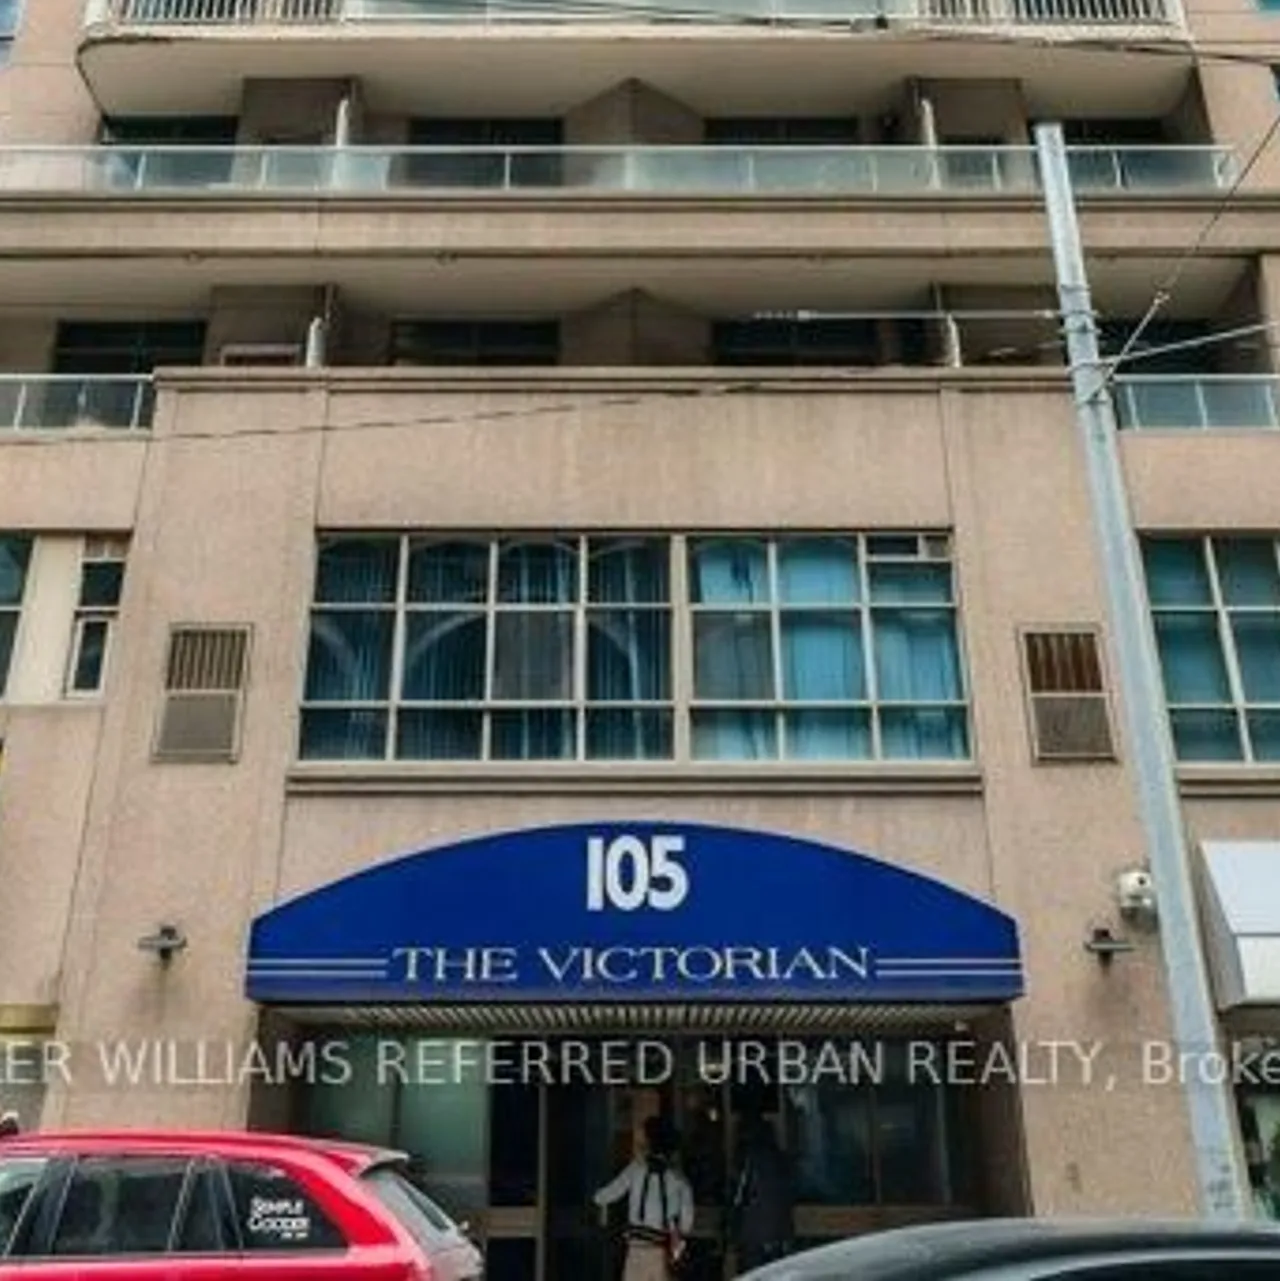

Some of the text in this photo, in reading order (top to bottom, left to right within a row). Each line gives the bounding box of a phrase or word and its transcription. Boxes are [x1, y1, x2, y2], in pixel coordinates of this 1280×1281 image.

[585, 834, 689, 912] 105
[392, 946, 868, 982] THE VICTORIAN
